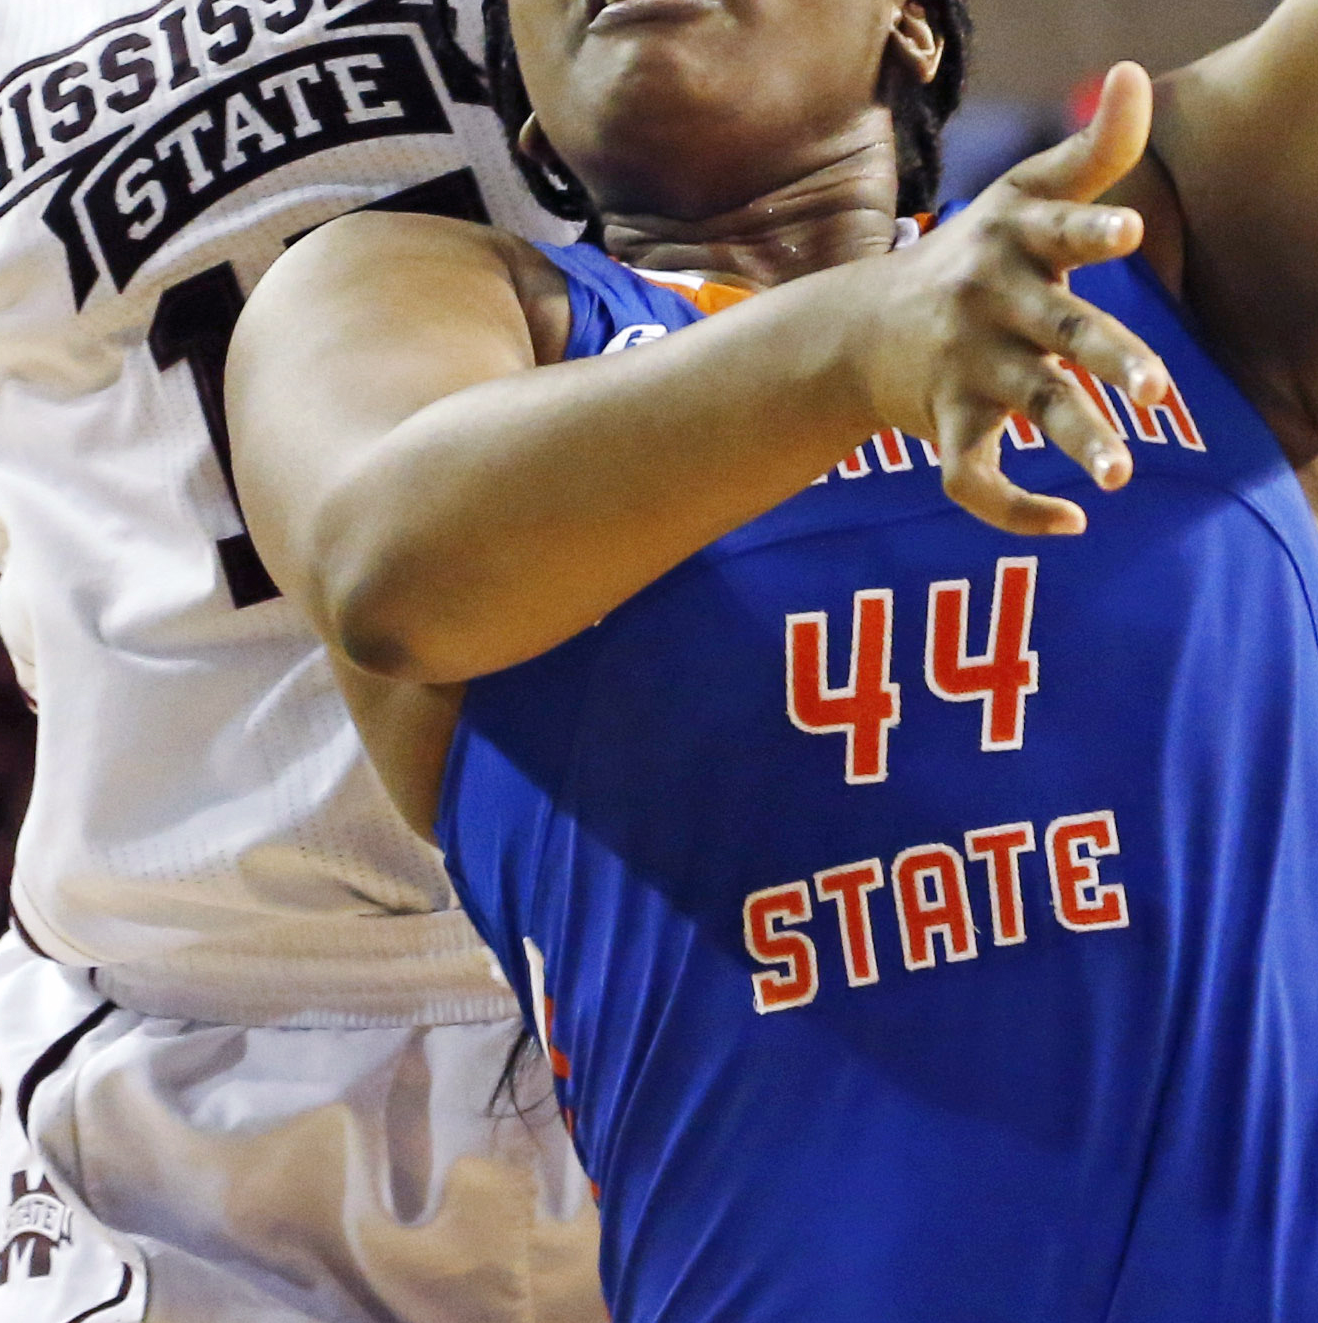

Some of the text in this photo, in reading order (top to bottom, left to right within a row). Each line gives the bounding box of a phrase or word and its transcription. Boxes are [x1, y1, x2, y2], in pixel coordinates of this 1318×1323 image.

[114, 52, 405, 240] STATE
[785, 556, 1039, 785] 44
[743, 810, 1129, 1014] STATE
